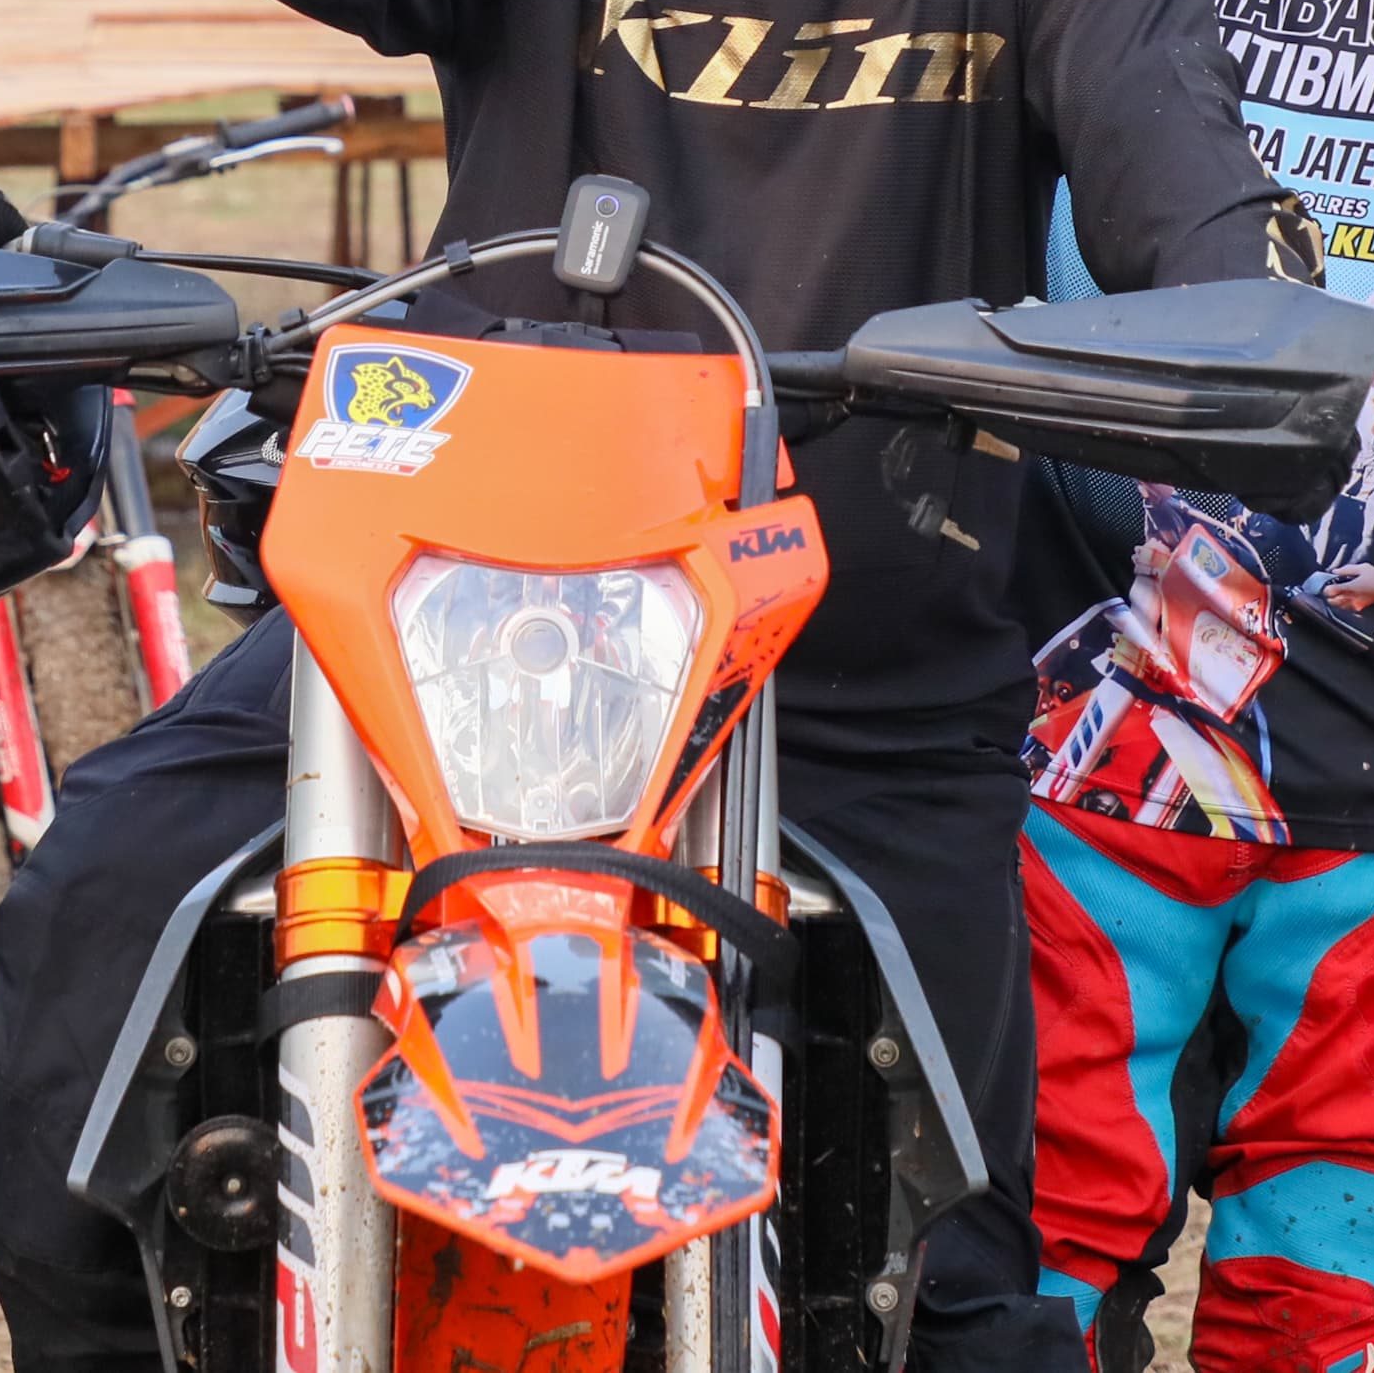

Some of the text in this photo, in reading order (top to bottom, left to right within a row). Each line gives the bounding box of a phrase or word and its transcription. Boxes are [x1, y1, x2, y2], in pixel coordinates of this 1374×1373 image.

[1295, 191, 1369, 219] OLRES
[580, 220, 604, 275] Saramonic
[296, 421, 449, 466] PETE
[729, 524, 806, 563] KTM
[484, 1148, 662, 1203] KTM
